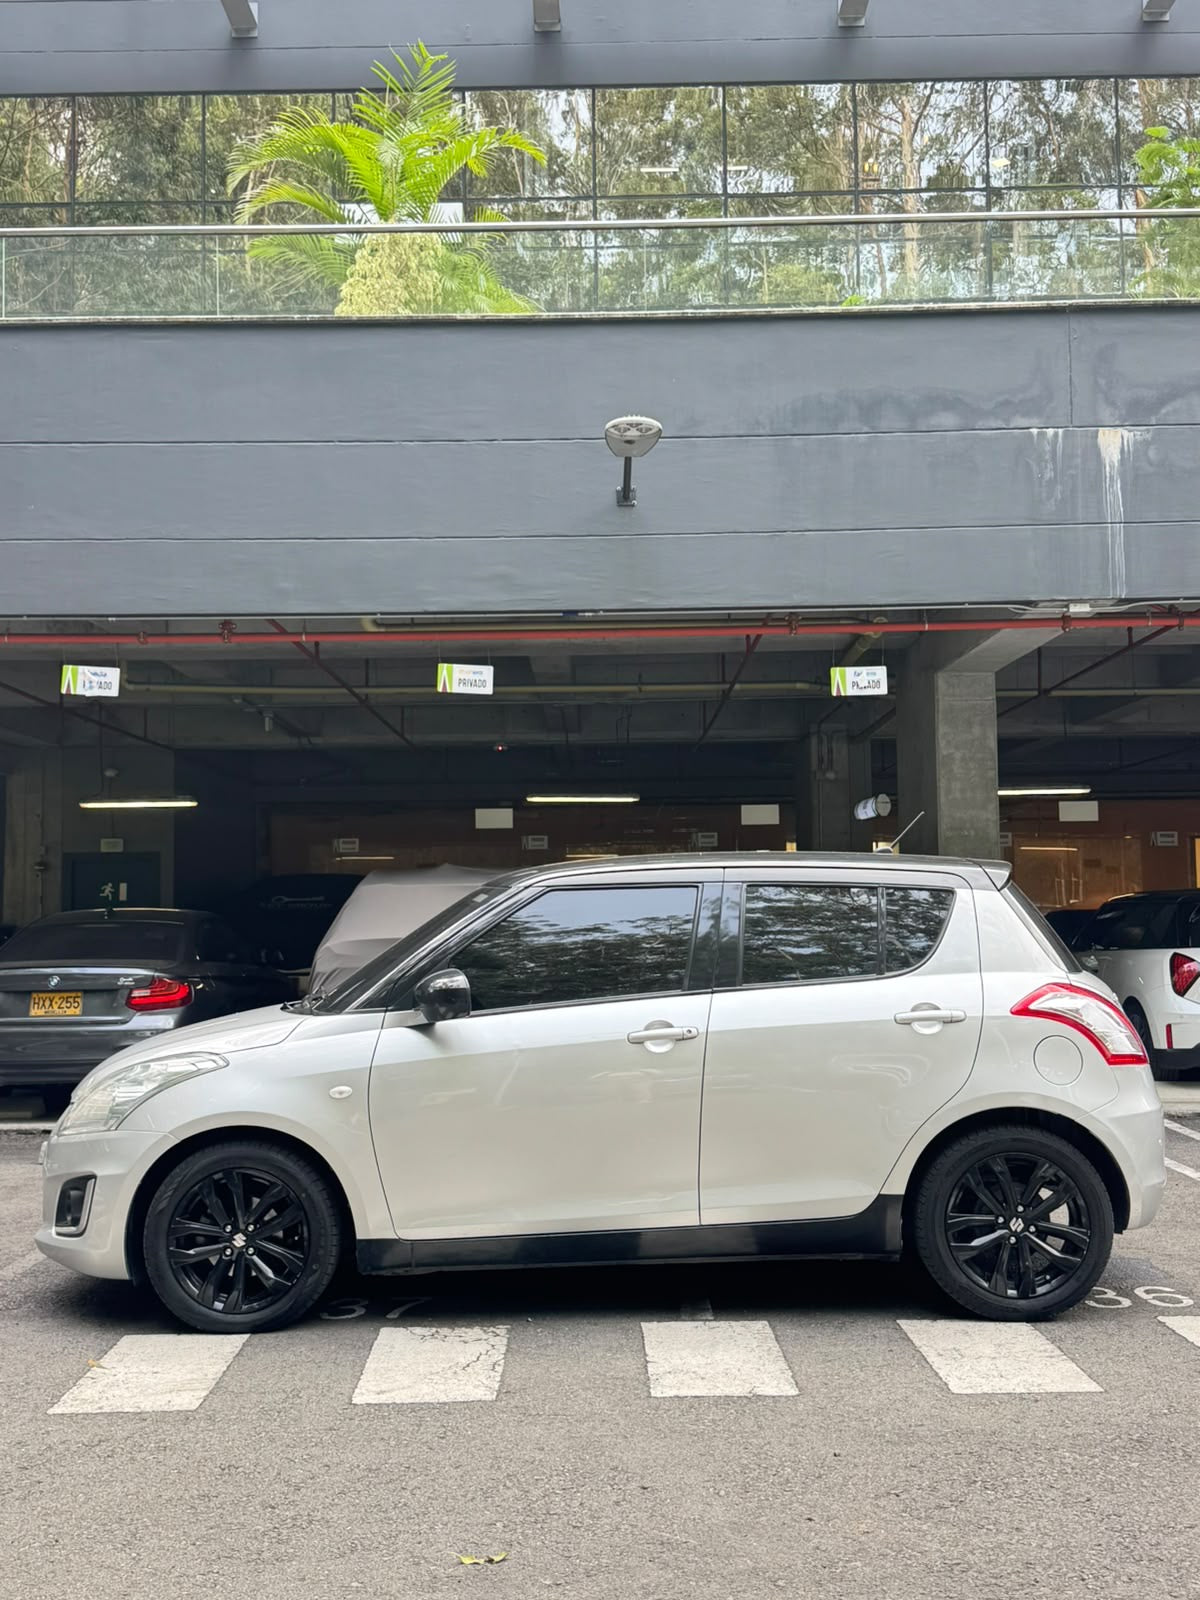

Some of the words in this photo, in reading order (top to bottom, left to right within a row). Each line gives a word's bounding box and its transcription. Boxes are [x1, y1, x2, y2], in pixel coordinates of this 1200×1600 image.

[457, 678, 487, 688] PRIVADO
[1084, 1286, 1194, 1308] 36
[320, 1298, 432, 1319] 37
